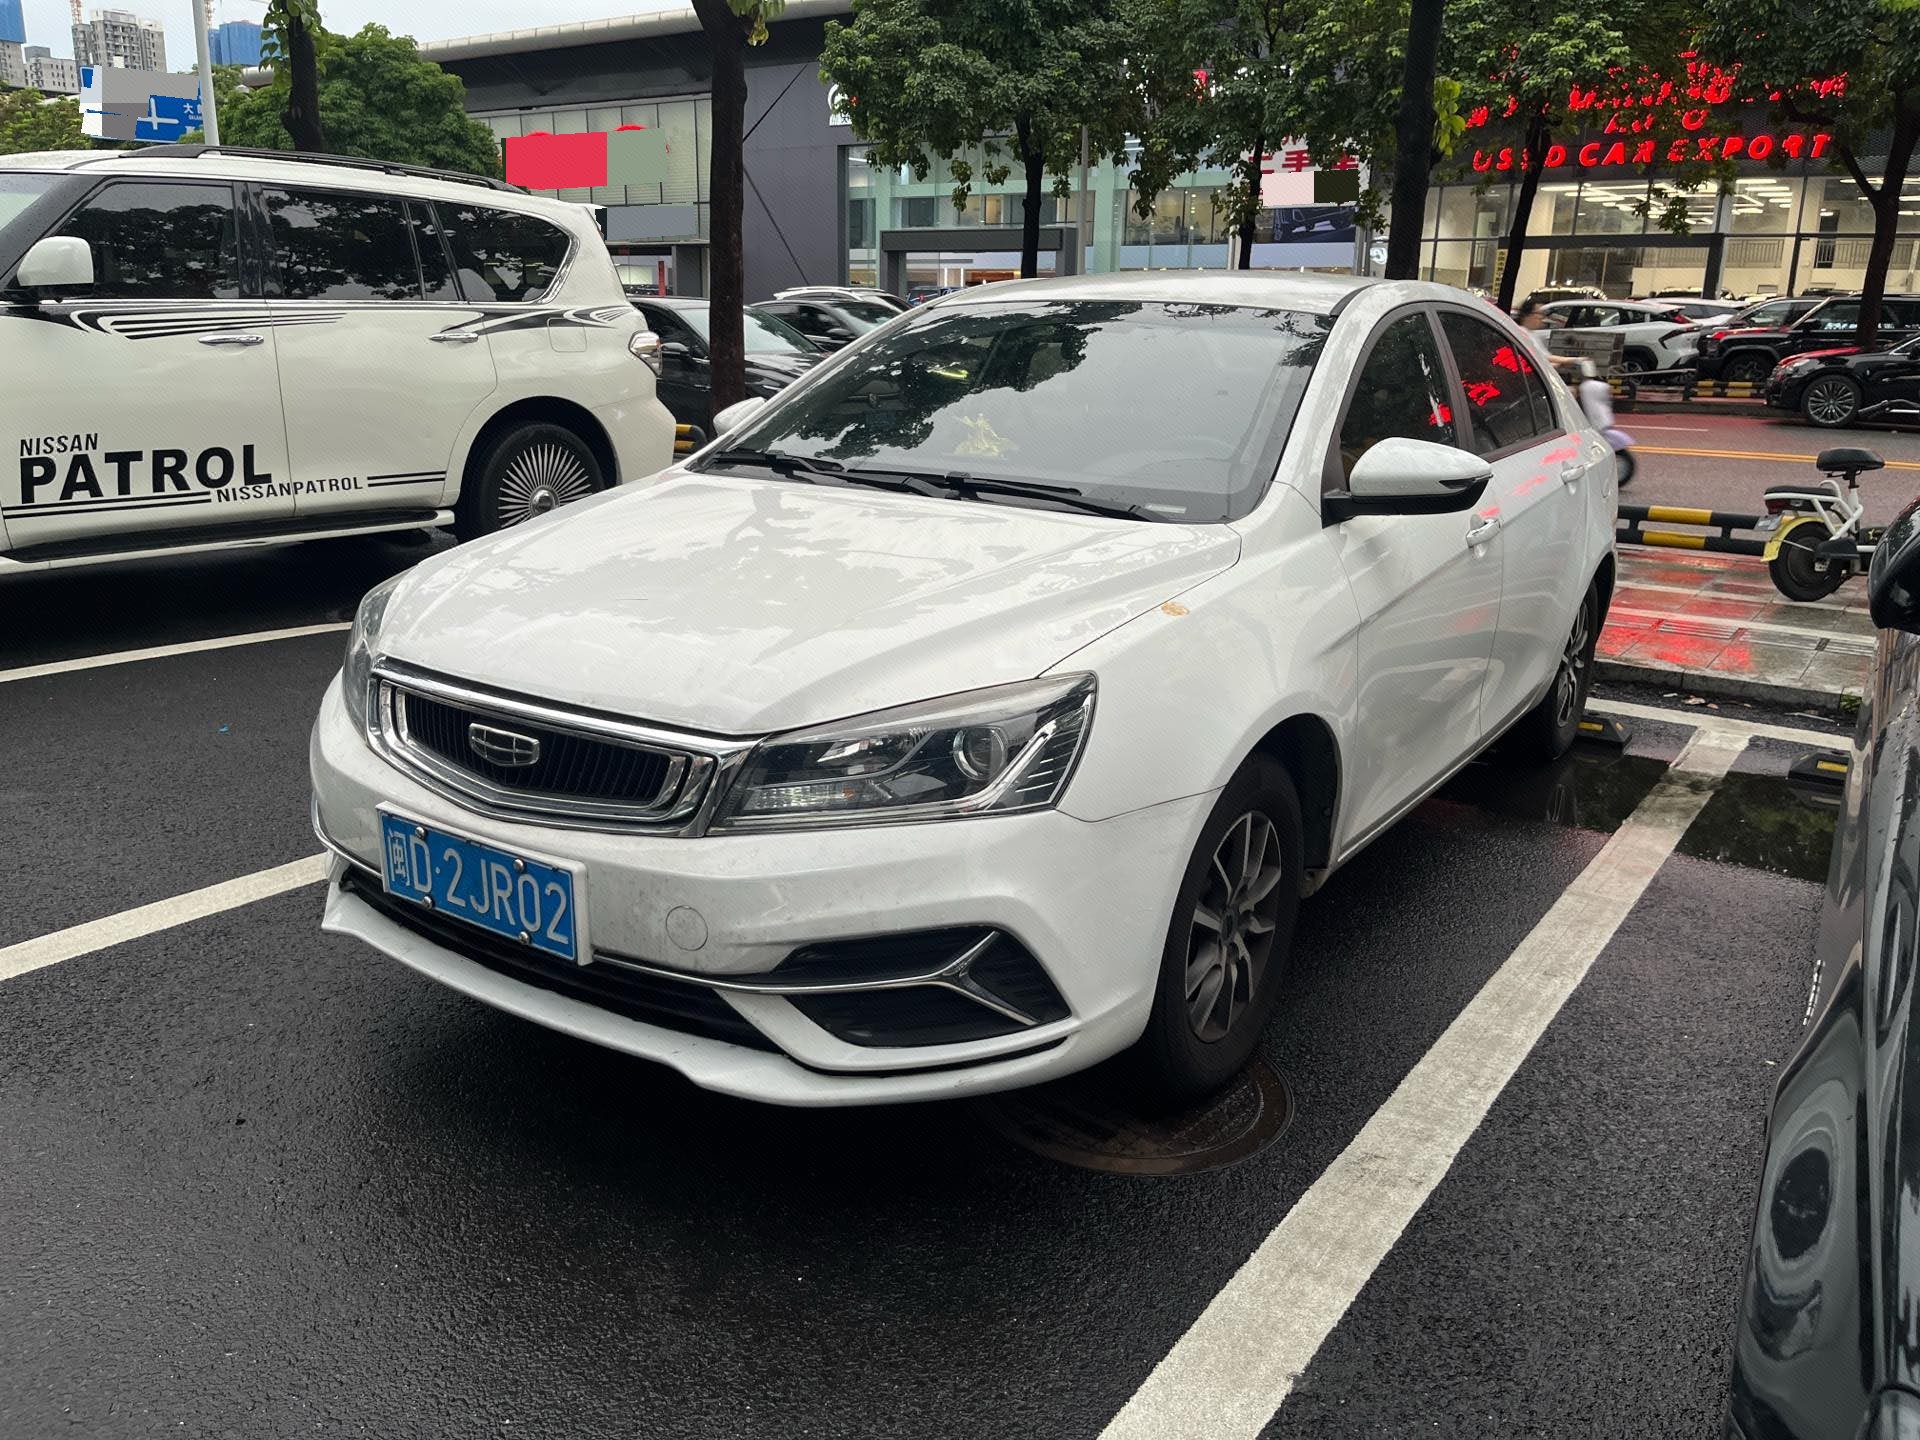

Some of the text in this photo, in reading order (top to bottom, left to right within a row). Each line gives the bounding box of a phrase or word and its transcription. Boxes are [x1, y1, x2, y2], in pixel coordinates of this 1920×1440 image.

[1473, 134, 1832, 172] USD CAR EXPORT
[20, 433, 98, 457] NISSAN
[20, 444, 272, 505] PATROL
